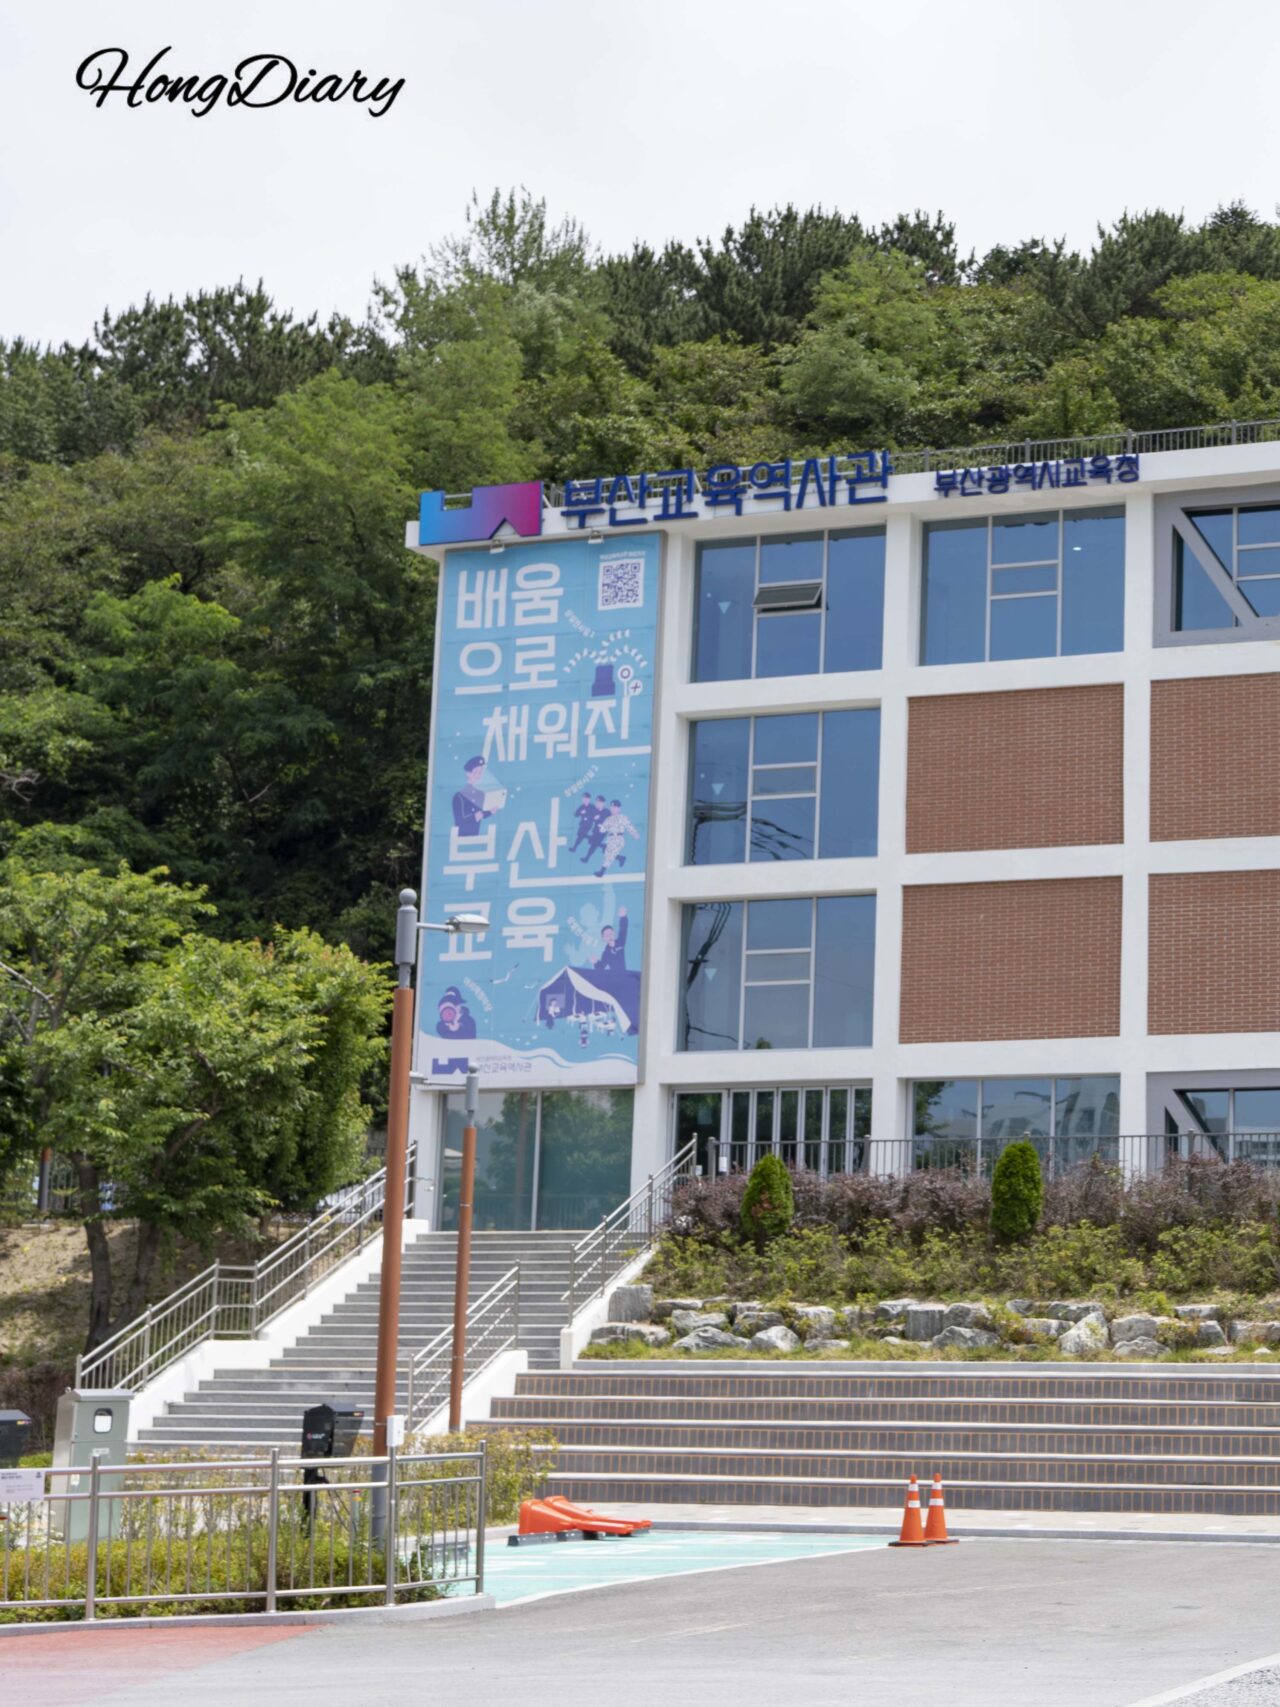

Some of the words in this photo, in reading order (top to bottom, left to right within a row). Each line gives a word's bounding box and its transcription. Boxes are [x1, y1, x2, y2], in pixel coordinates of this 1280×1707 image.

[560, 449, 896, 529] 부산교육역사관
[934, 451, 1140, 498] 부산광역시교육청
[456, 562, 564, 629] 배움
[454, 635, 558, 695] 으로
[482, 696, 652, 762] 채워진
[443, 797, 646, 891] 부산
[439, 897, 559, 962] 교육
